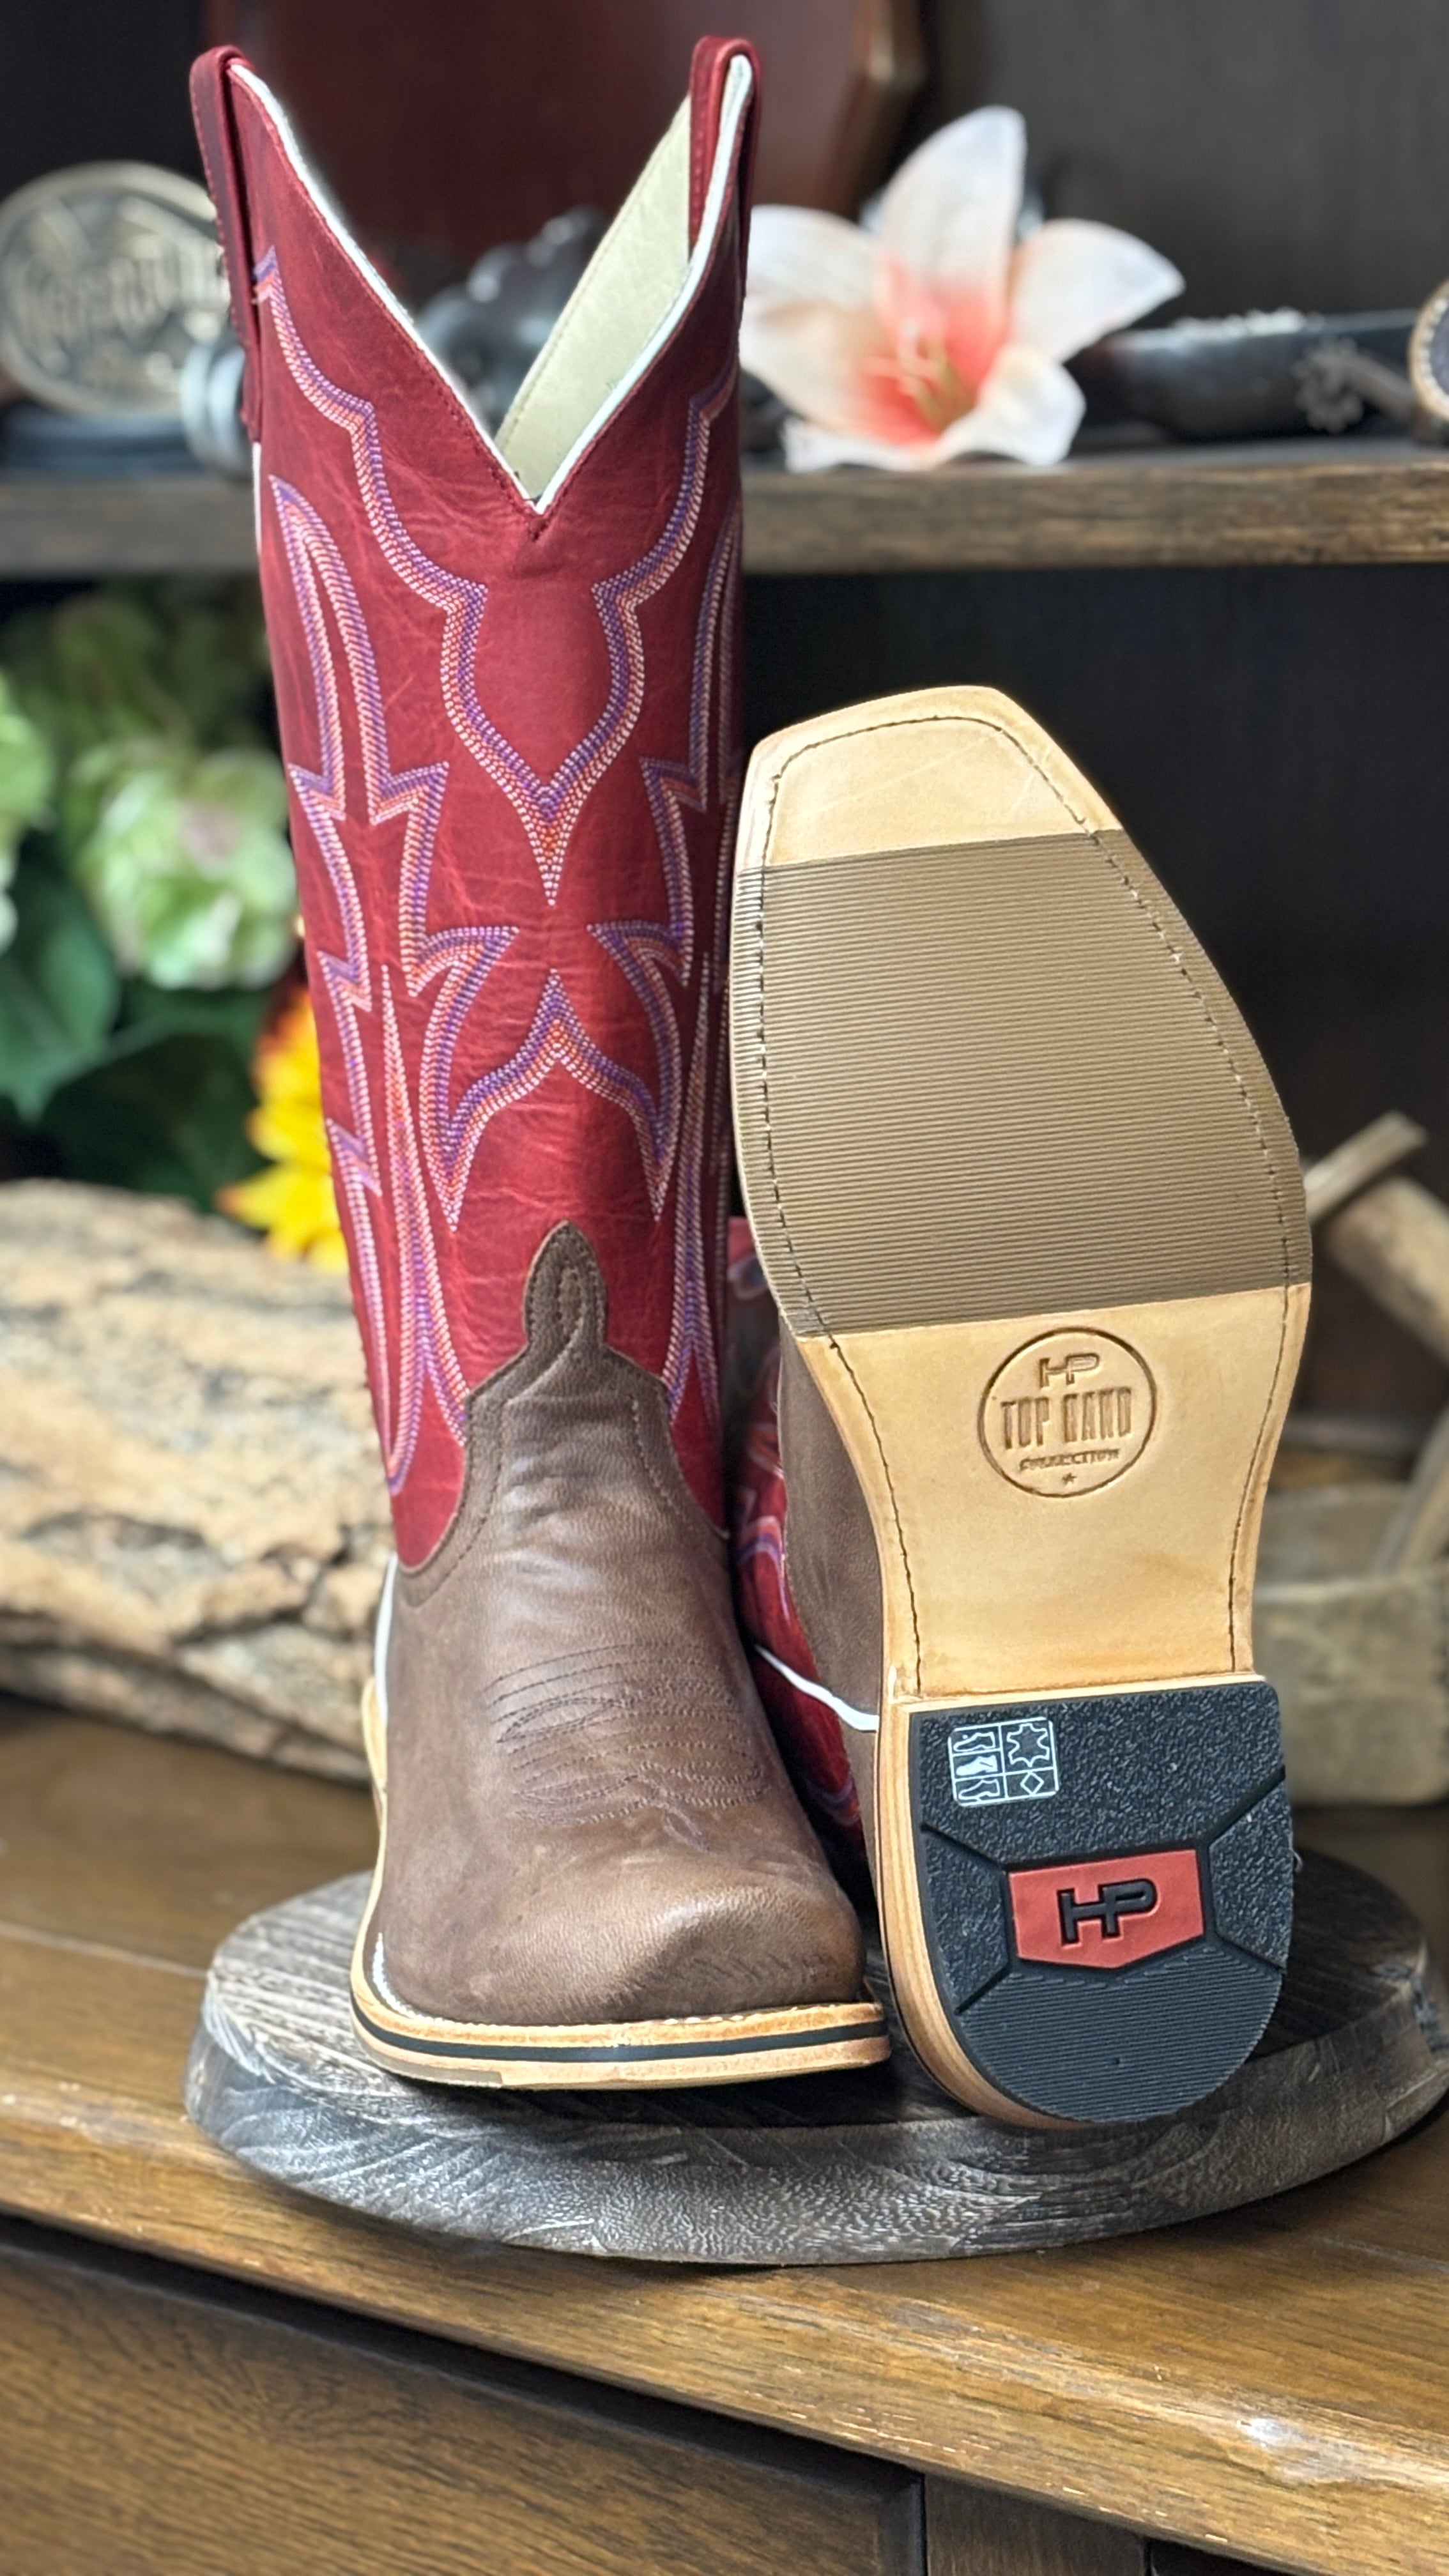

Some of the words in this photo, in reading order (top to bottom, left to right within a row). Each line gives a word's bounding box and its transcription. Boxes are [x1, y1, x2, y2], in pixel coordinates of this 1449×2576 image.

[1038, 1353, 1100, 1389] HP
[1000, 1397, 1050, 1450] TOP
[1057, 1878, 1158, 1947] HP
